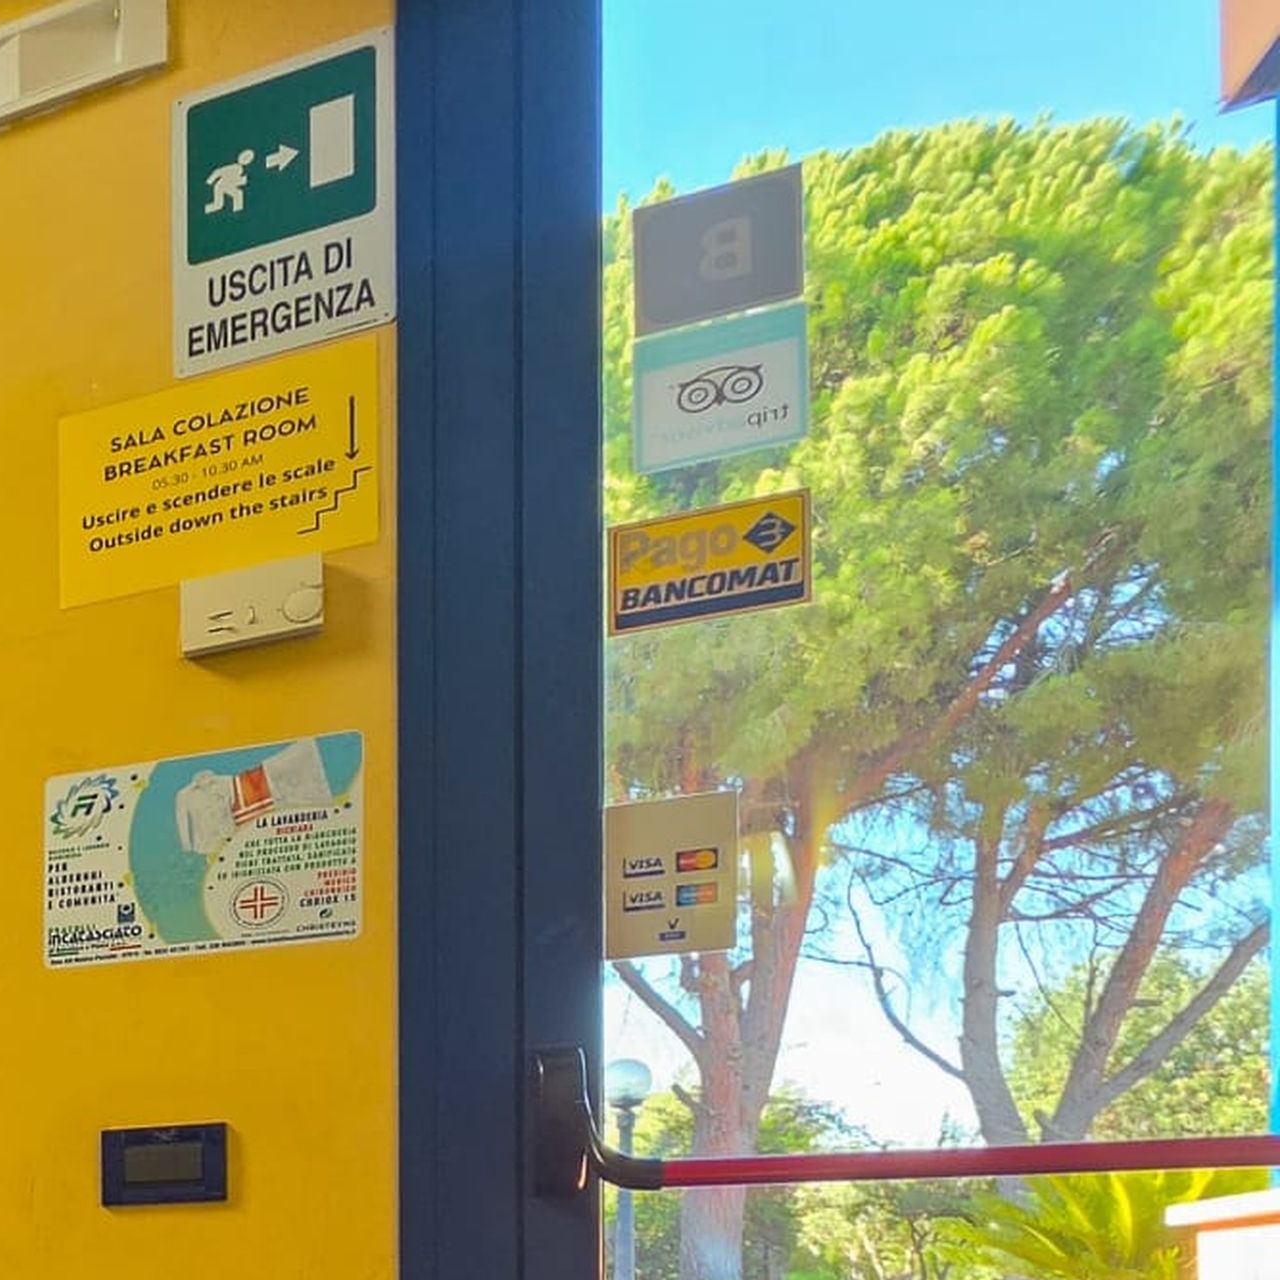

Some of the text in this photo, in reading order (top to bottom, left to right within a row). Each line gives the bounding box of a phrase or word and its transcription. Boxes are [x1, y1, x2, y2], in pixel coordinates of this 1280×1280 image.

[209, 238, 352, 307] USCITA DI
[188, 279, 375, 357] EMERGENZA
[104, 415, 317, 482] BREAKFAST ROOM
[110, 387, 310, 453] SALA COLAZIONE
[241, 454, 264, 470] AM
[82, 457, 336, 530] Uscire e scendere le scale
[90, 486, 328, 553] Outside down the stairs
[618, 522, 737, 575] Pago
[620, 558, 800, 612] BANCOMAT
[256, 810, 328, 828] LA LAVANDERIA
[629, 858, 663, 870] VISA
[629, 891, 663, 904] VISA
